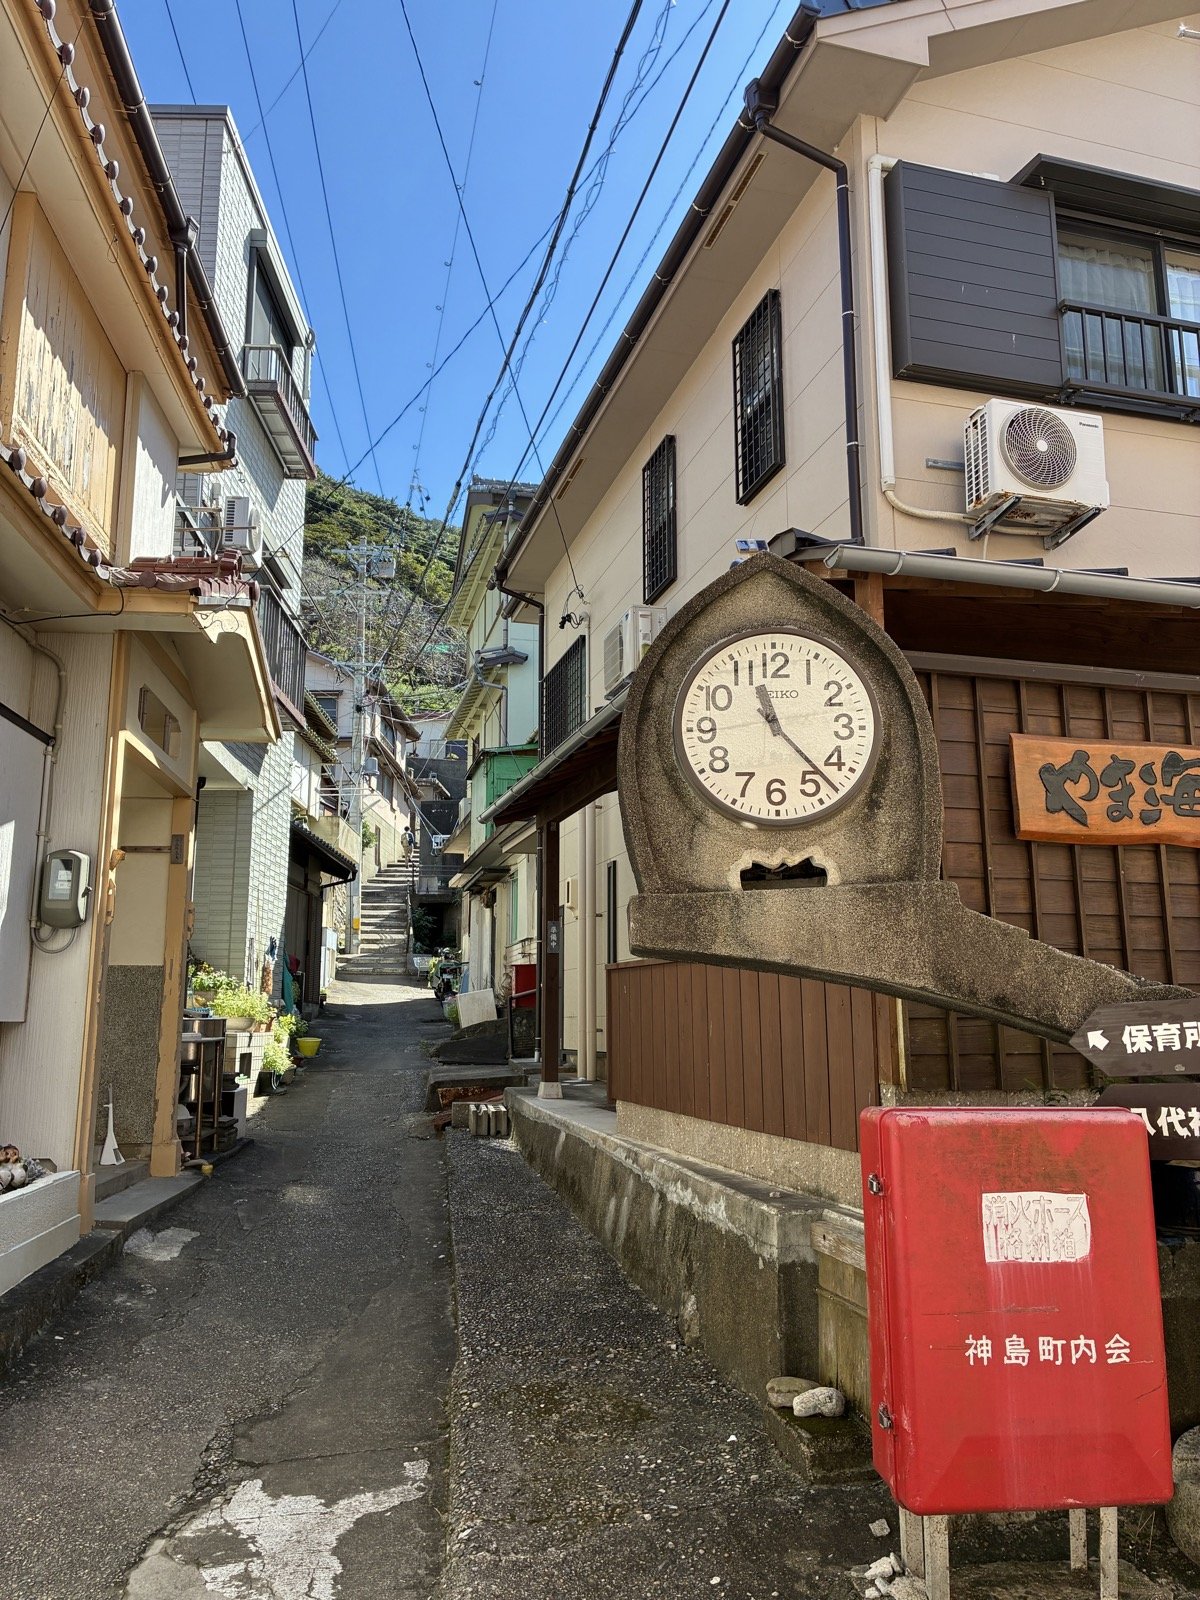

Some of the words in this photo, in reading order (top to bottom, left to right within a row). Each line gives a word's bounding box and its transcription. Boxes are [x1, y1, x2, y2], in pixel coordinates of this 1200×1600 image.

[733, 660, 753, 686] 11
[762, 651, 790, 679] 12
[805, 659, 812, 685] 1
[705, 684, 733, 711] 10
[823, 680, 844, 707] 2
[696, 716, 717, 743] 9
[833, 713, 855, 740] 3
[708, 745, 730, 773] 8
[823, 745, 846, 772] 4
[735, 771, 756, 798] 7
[765, 778, 787, 806] 6
[799, 770, 821, 797] 5
[965, 1333, 1131, 1366] 神島町内会
